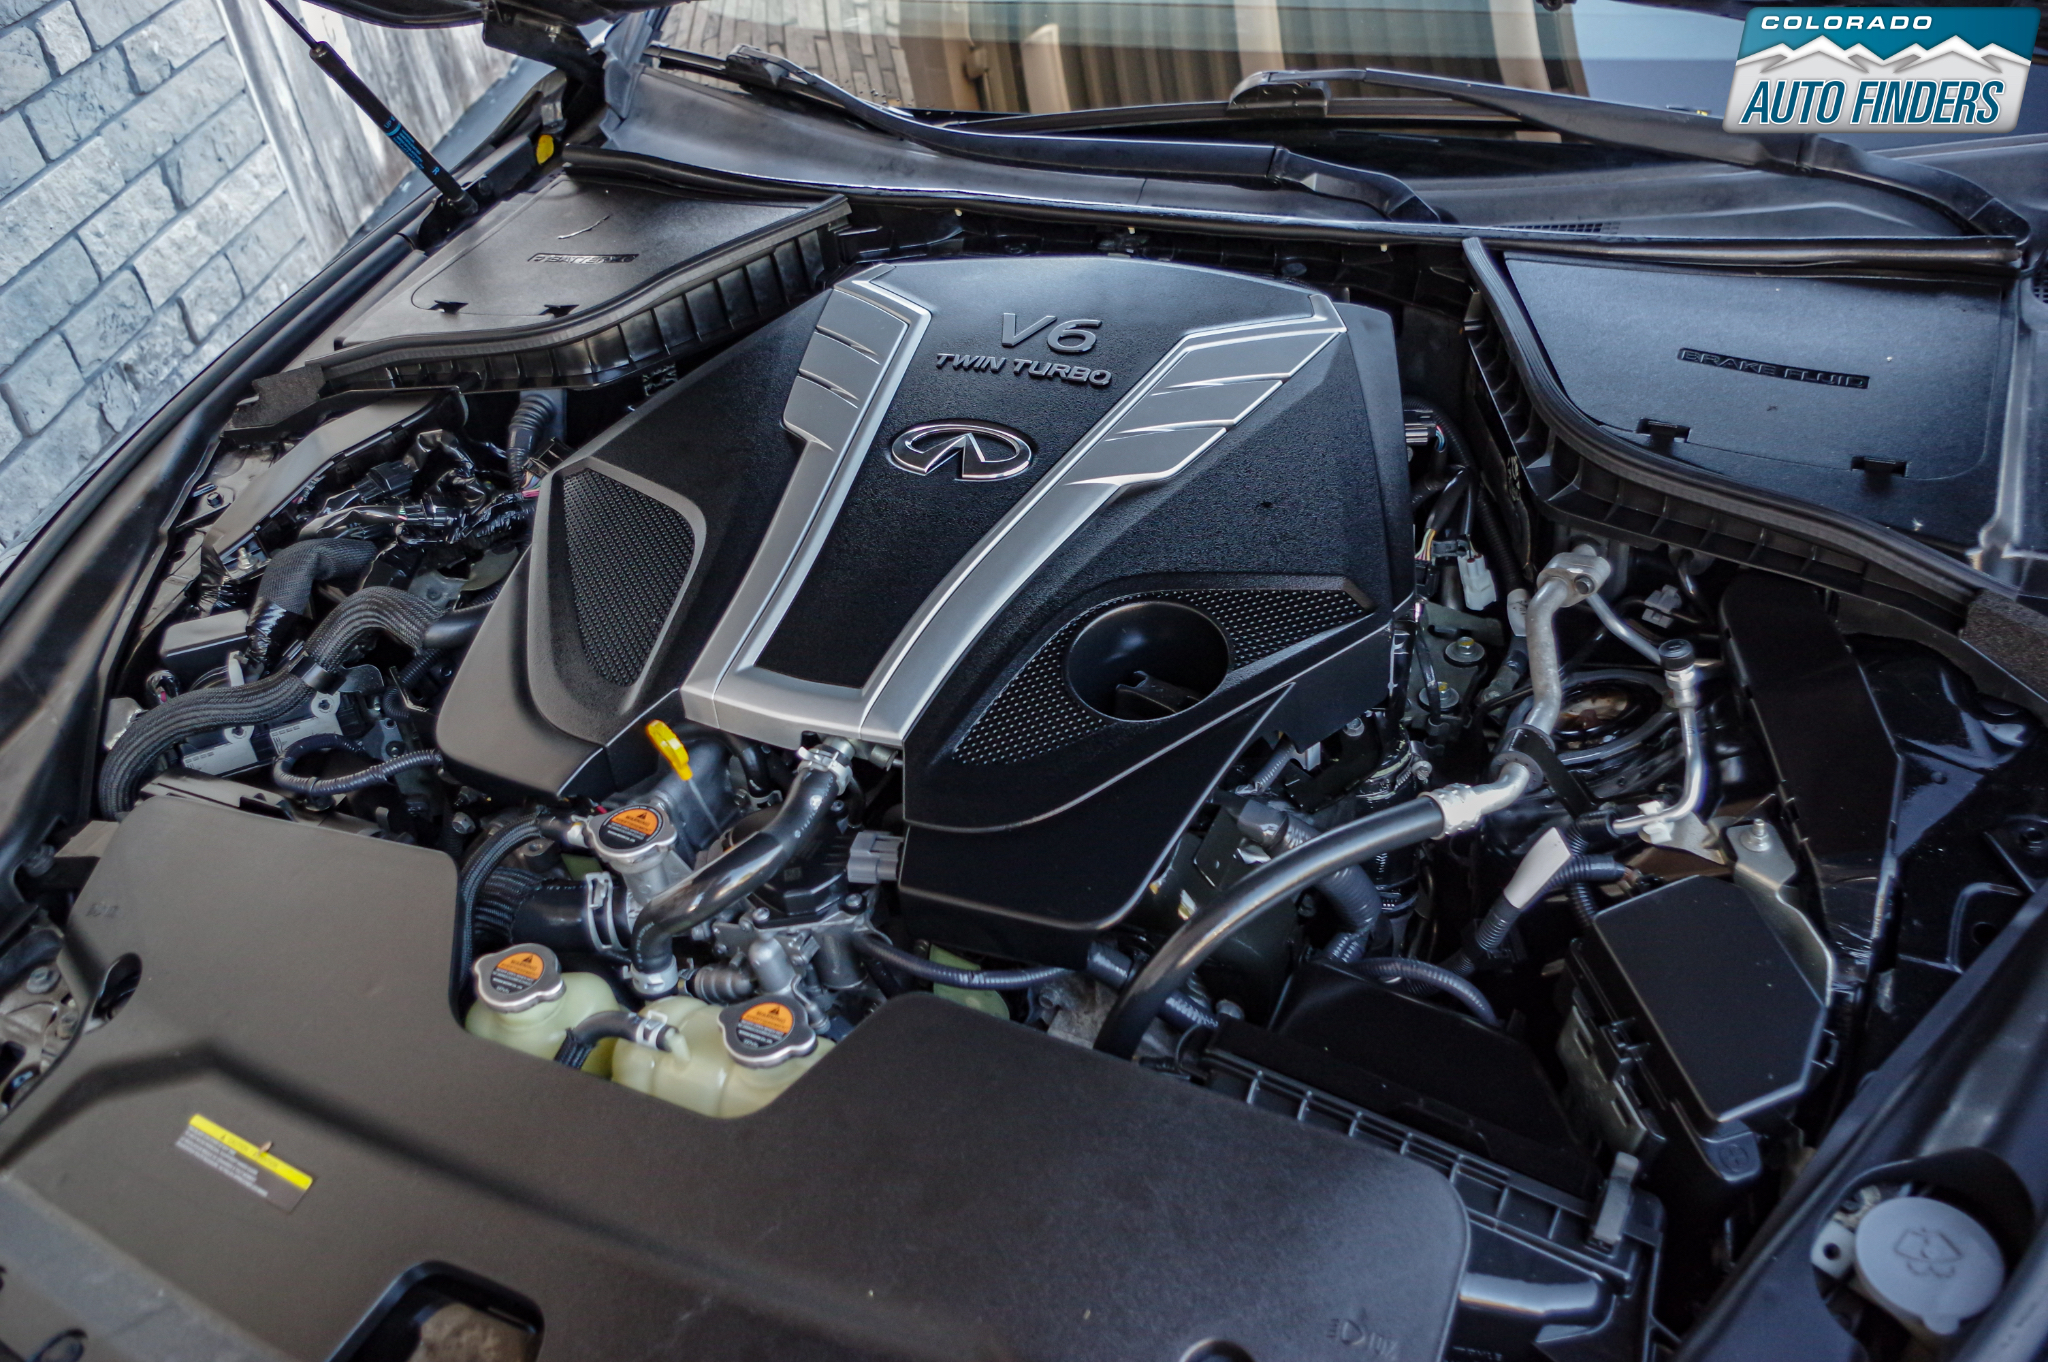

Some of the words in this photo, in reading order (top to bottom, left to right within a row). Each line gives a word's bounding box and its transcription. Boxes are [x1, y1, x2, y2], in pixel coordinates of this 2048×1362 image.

[1002, 312, 1103, 354] V6
[936, 352, 1007, 373] TWIN
[1013, 358, 1113, 387] TURBO
[1680, 349, 1777, 376] BRAKE
[1784, 367, 1869, 389] FLUID
